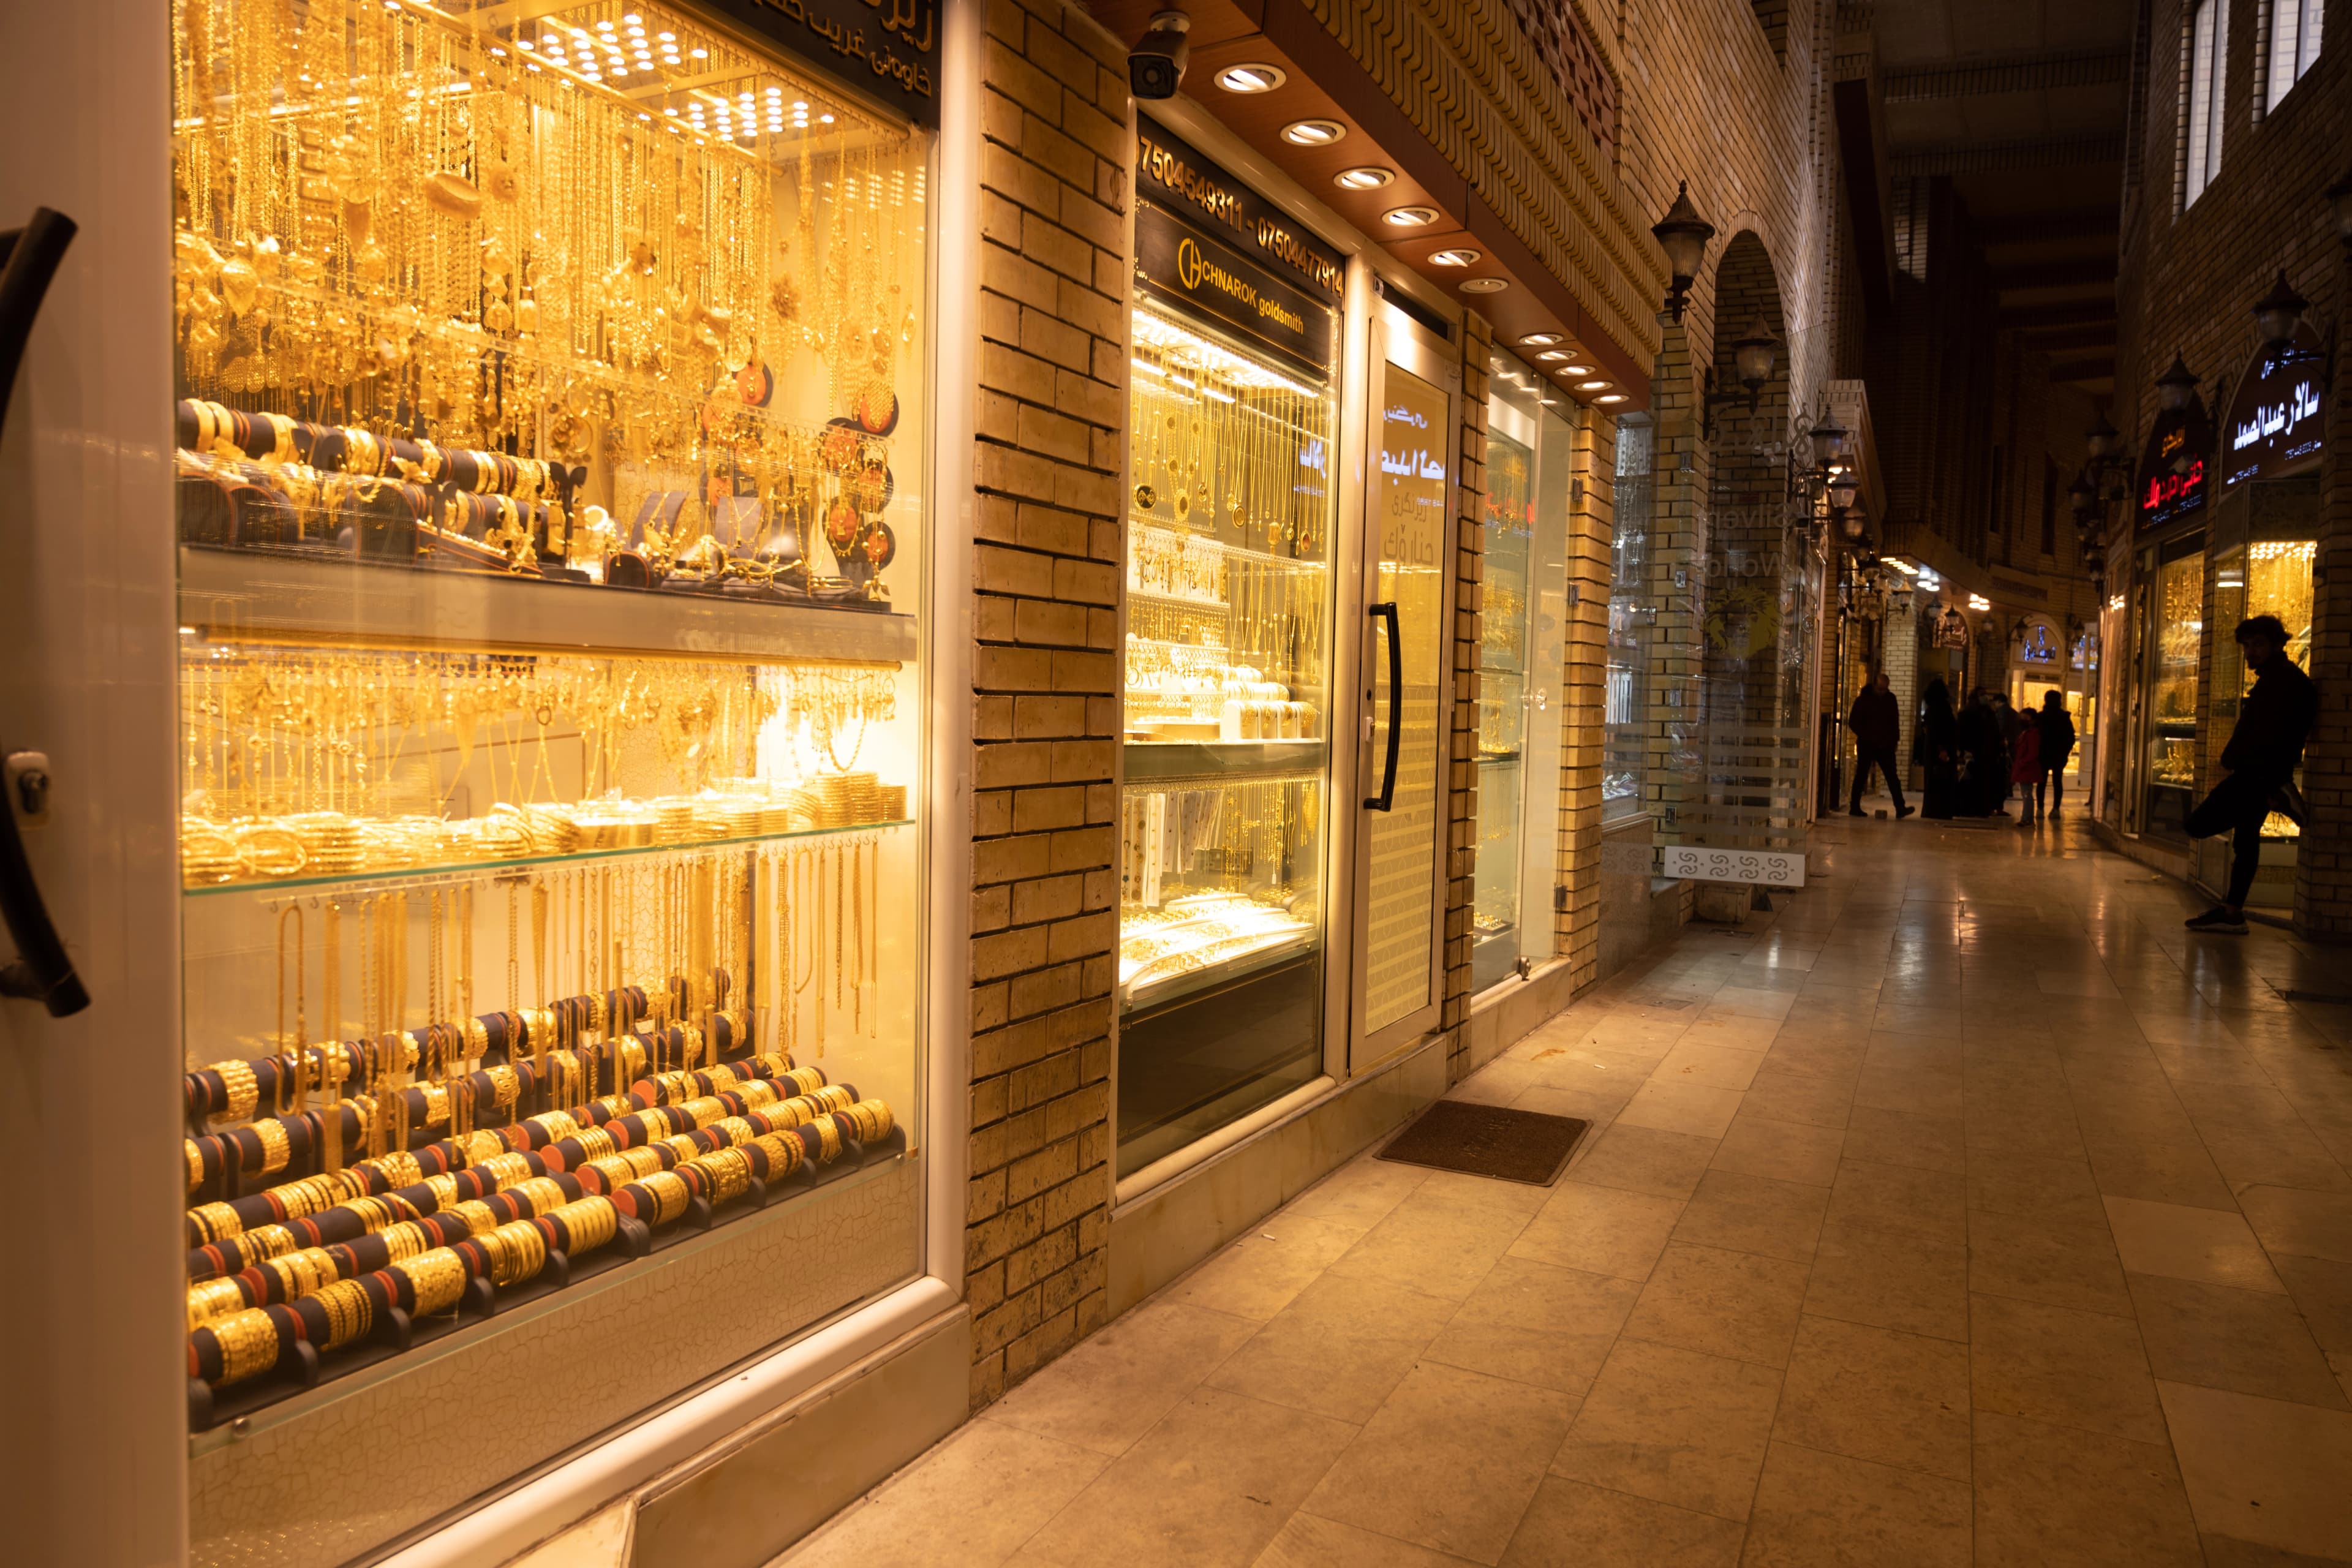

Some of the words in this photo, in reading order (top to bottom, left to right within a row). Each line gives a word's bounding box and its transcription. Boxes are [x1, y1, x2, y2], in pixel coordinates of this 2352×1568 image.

[1257, 216, 1344, 298] 07504477914
[1202, 260, 1257, 308] CHNAROK
[1259, 298, 1303, 334] goldsmith
